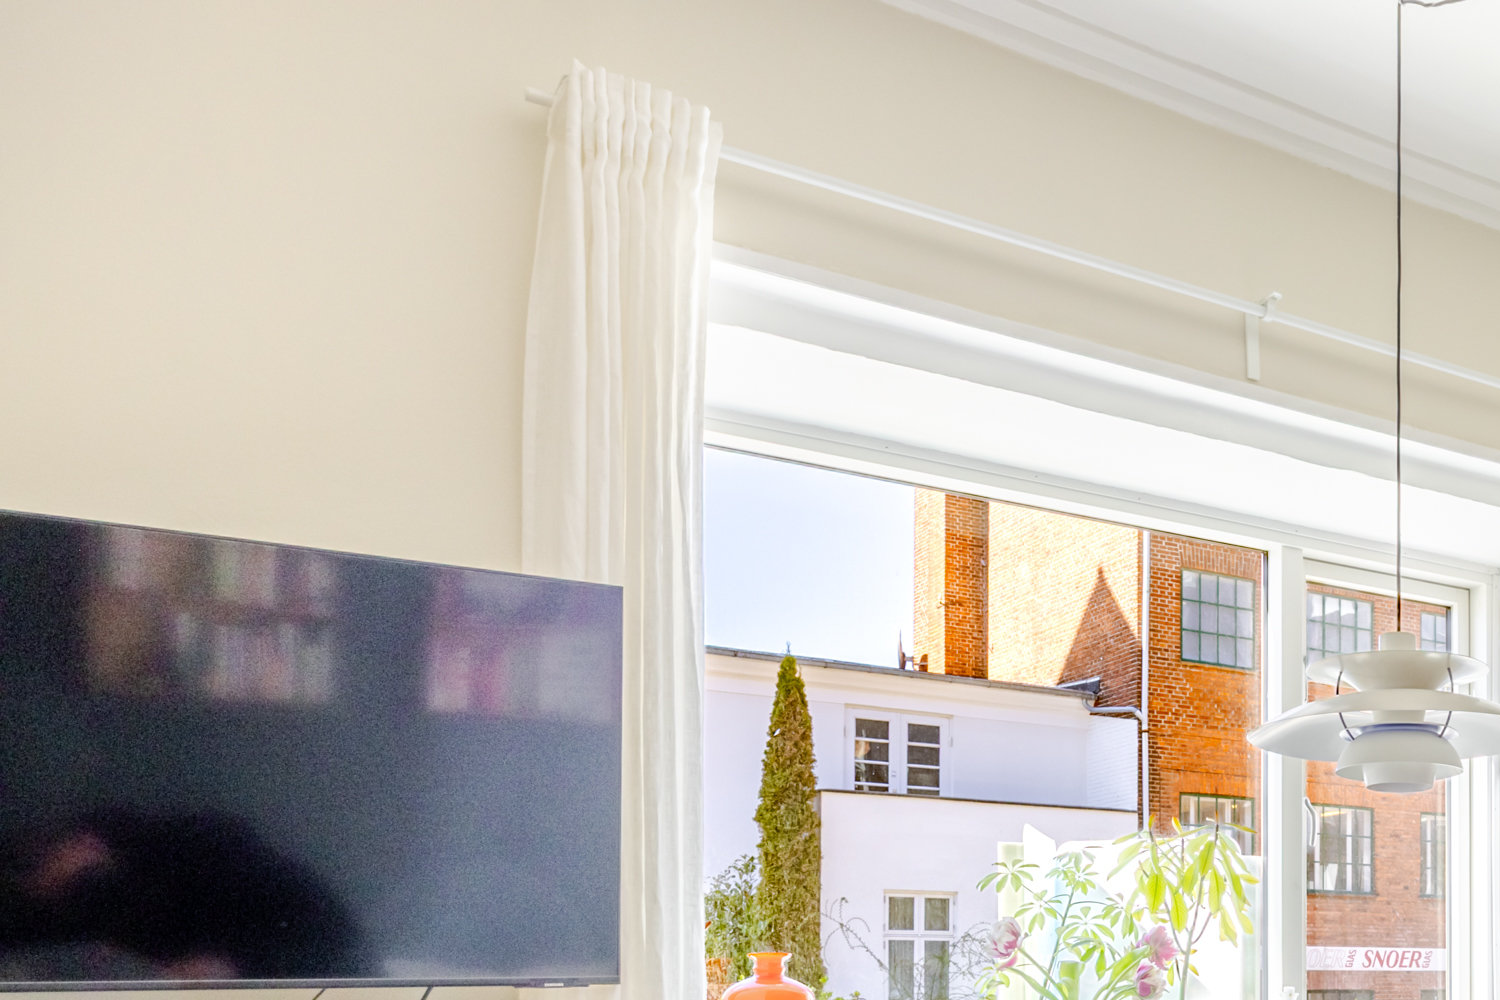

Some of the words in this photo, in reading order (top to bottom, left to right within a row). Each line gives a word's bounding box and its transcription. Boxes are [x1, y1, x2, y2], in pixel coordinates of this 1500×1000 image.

[1344, 949, 1356, 968] GLAS
[1362, 949, 1423, 969] SNOER
[1422, 950, 1433, 968] GLAS
